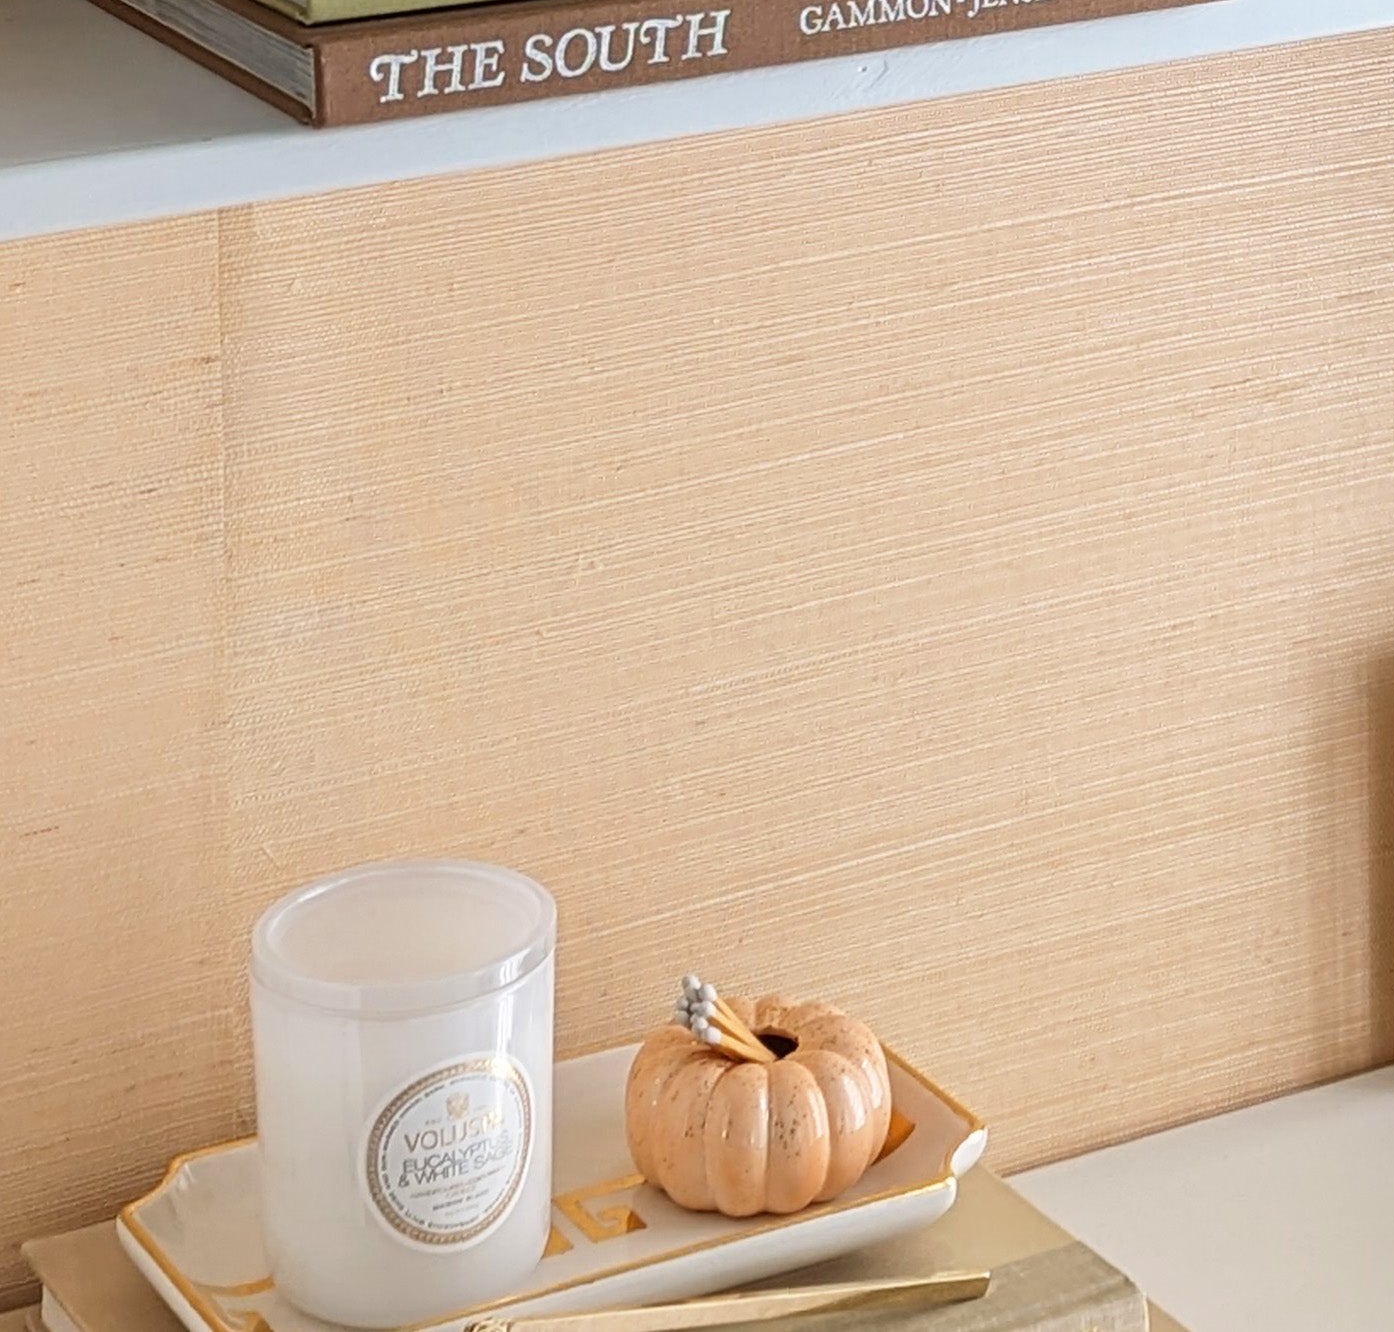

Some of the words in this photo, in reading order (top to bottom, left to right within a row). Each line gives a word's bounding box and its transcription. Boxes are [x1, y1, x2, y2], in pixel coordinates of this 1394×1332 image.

[369, 39, 506, 104] THE
[519, 8, 732, 84] SOUTH
[414, 1158, 470, 1185] WHITE
